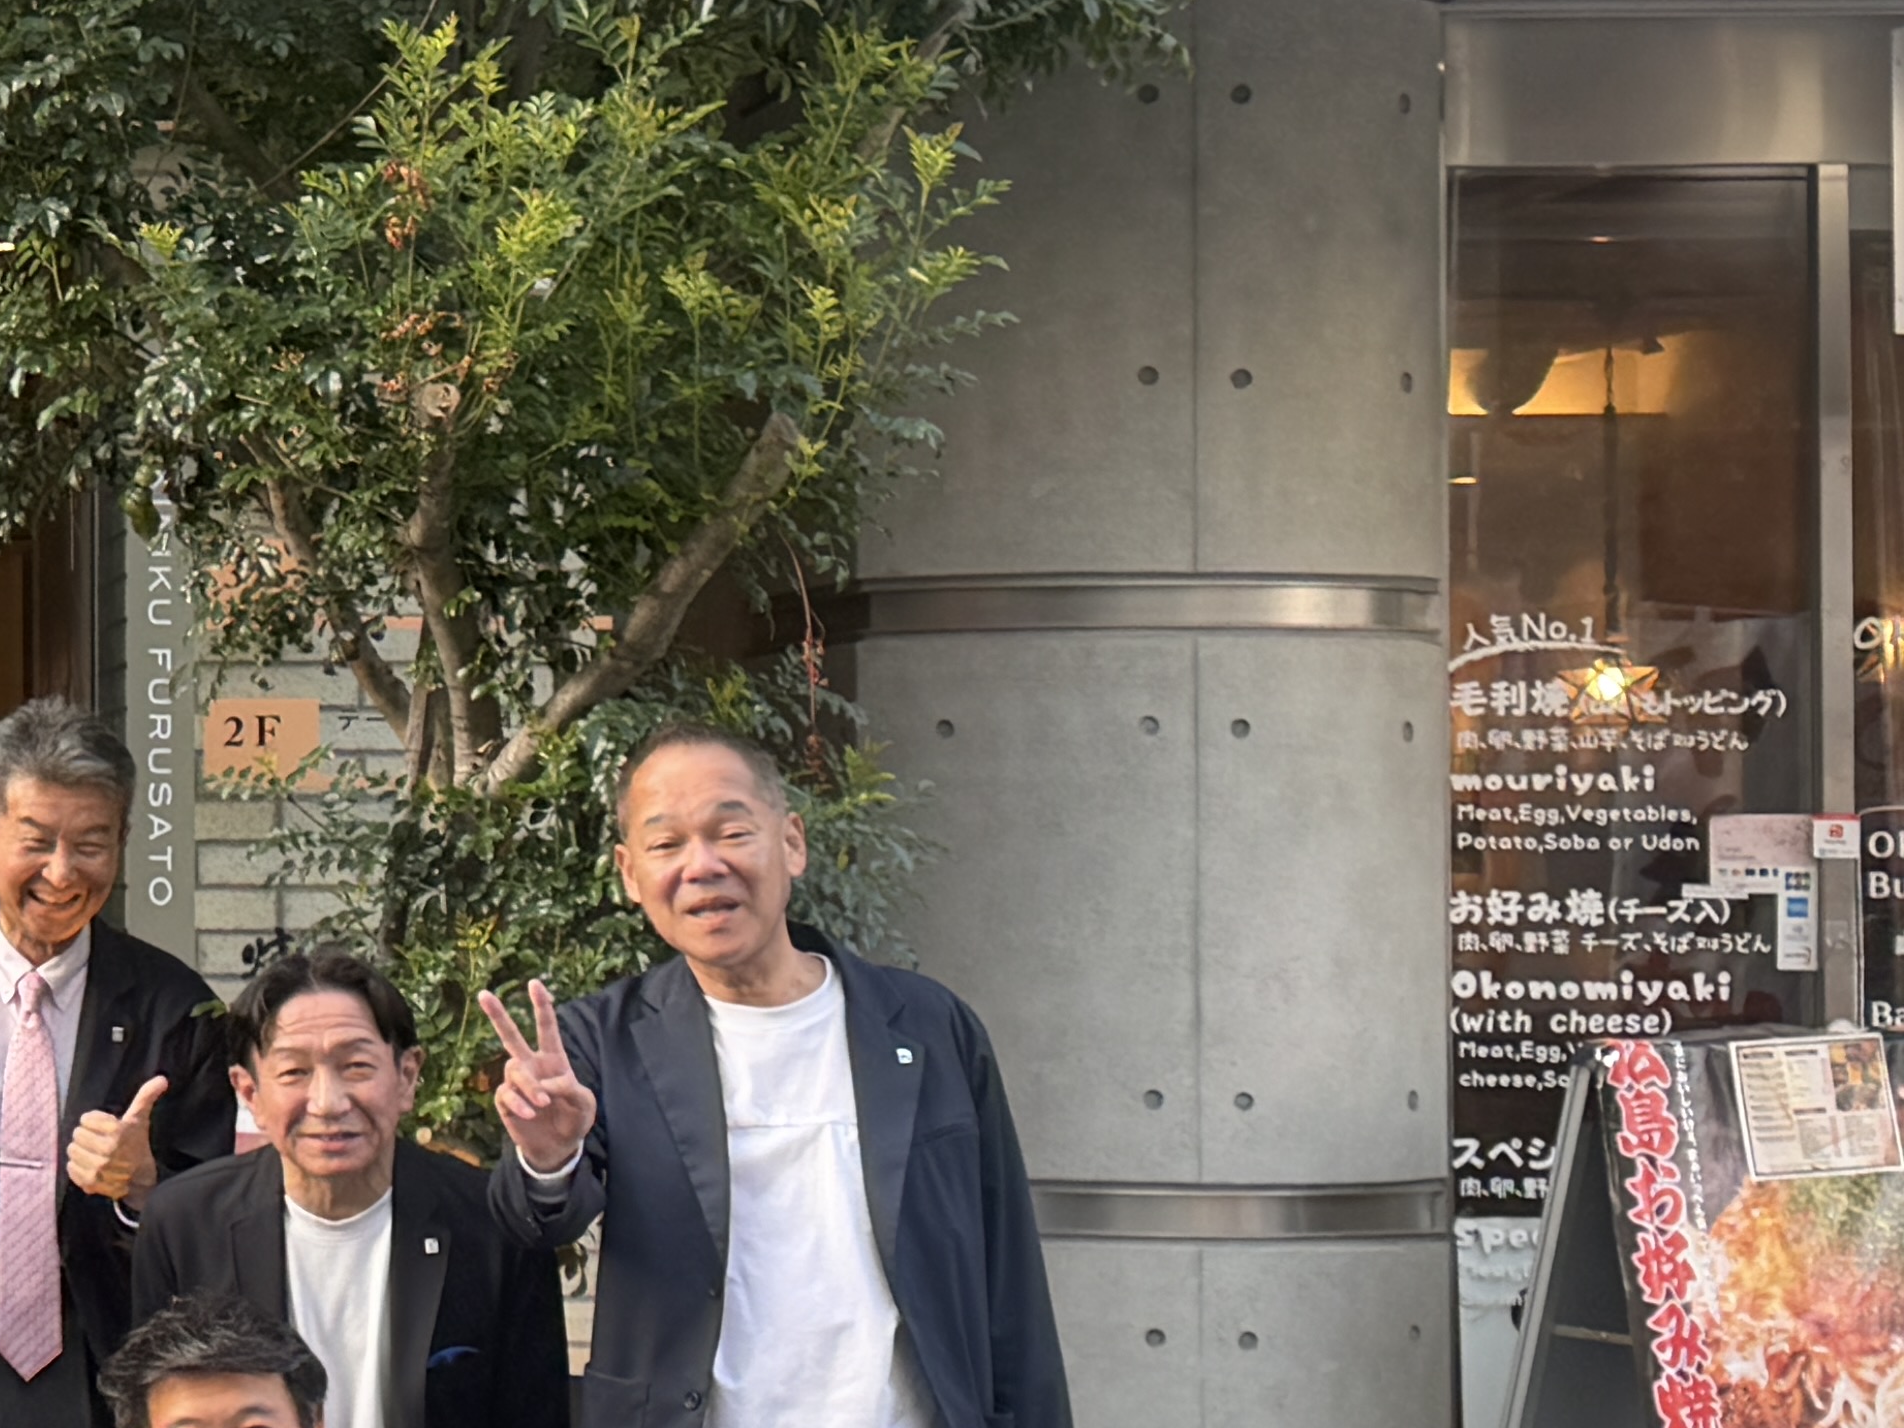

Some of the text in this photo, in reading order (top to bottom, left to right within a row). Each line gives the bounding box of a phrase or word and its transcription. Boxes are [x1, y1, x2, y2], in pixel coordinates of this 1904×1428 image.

[223, 714, 282, 748] 2F
[147, 646, 173, 907] FURUSATO
[1449, 764, 1656, 796] mouriyaki
[1608, 837, 1633, 851] or
[1642, 833, 1701, 851] Udon
[1448, 887, 1732, 927] お好み焼(チーズ入)
[1450, 969, 1732, 1006] Okonomiyaki
[1449, 1007, 1673, 1035] (with cheese)
